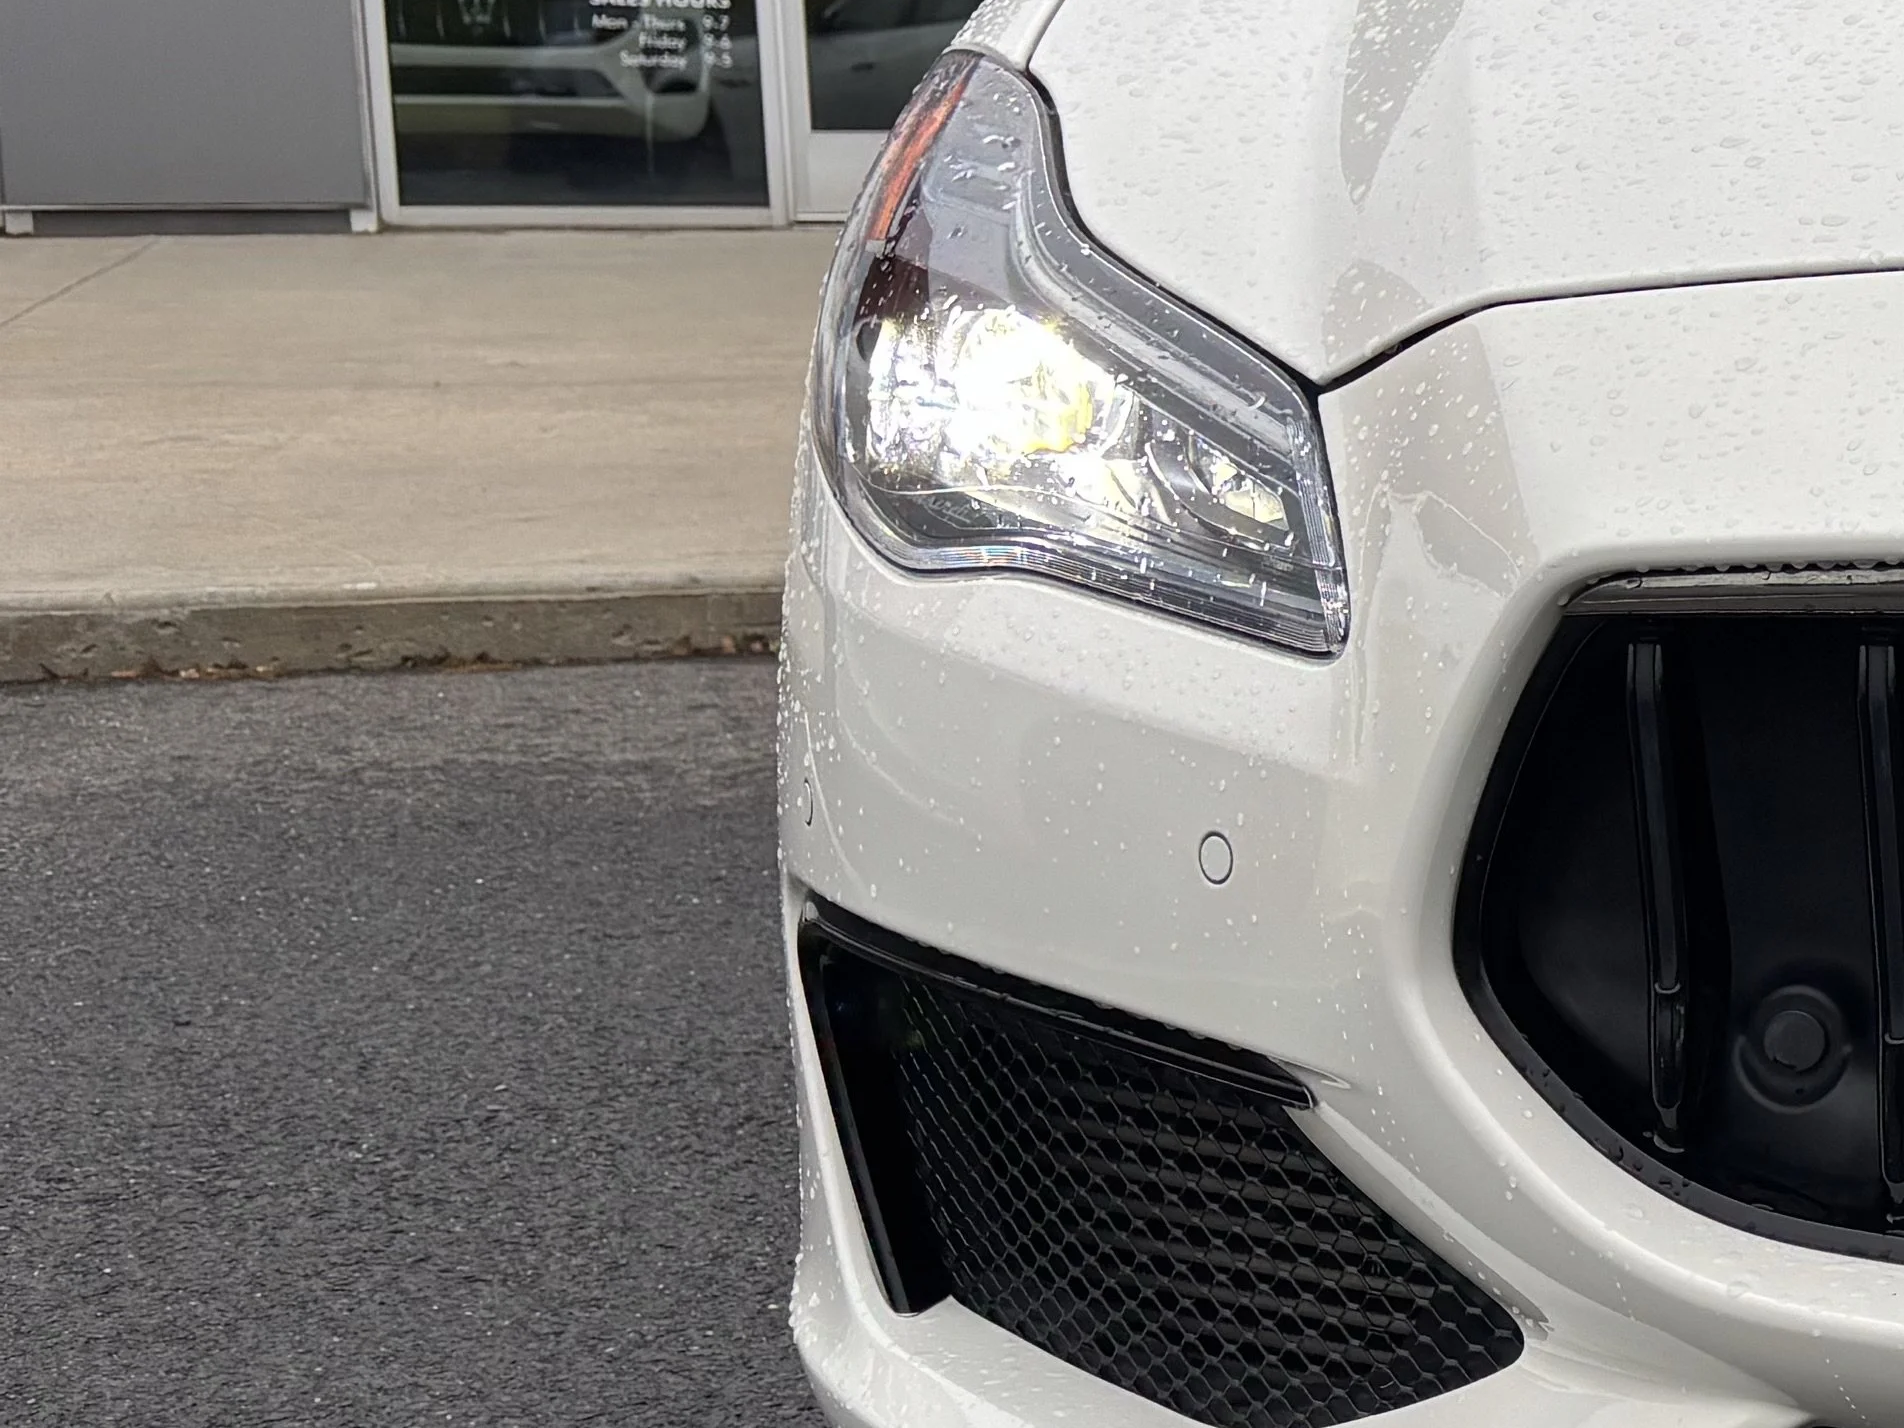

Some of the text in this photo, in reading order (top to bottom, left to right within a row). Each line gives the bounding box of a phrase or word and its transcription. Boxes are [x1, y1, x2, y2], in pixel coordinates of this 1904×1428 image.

[592, 13, 629, 30] Mon
[639, 31, 687, 52] Friday
[620, 50, 688, 71] Saturday
